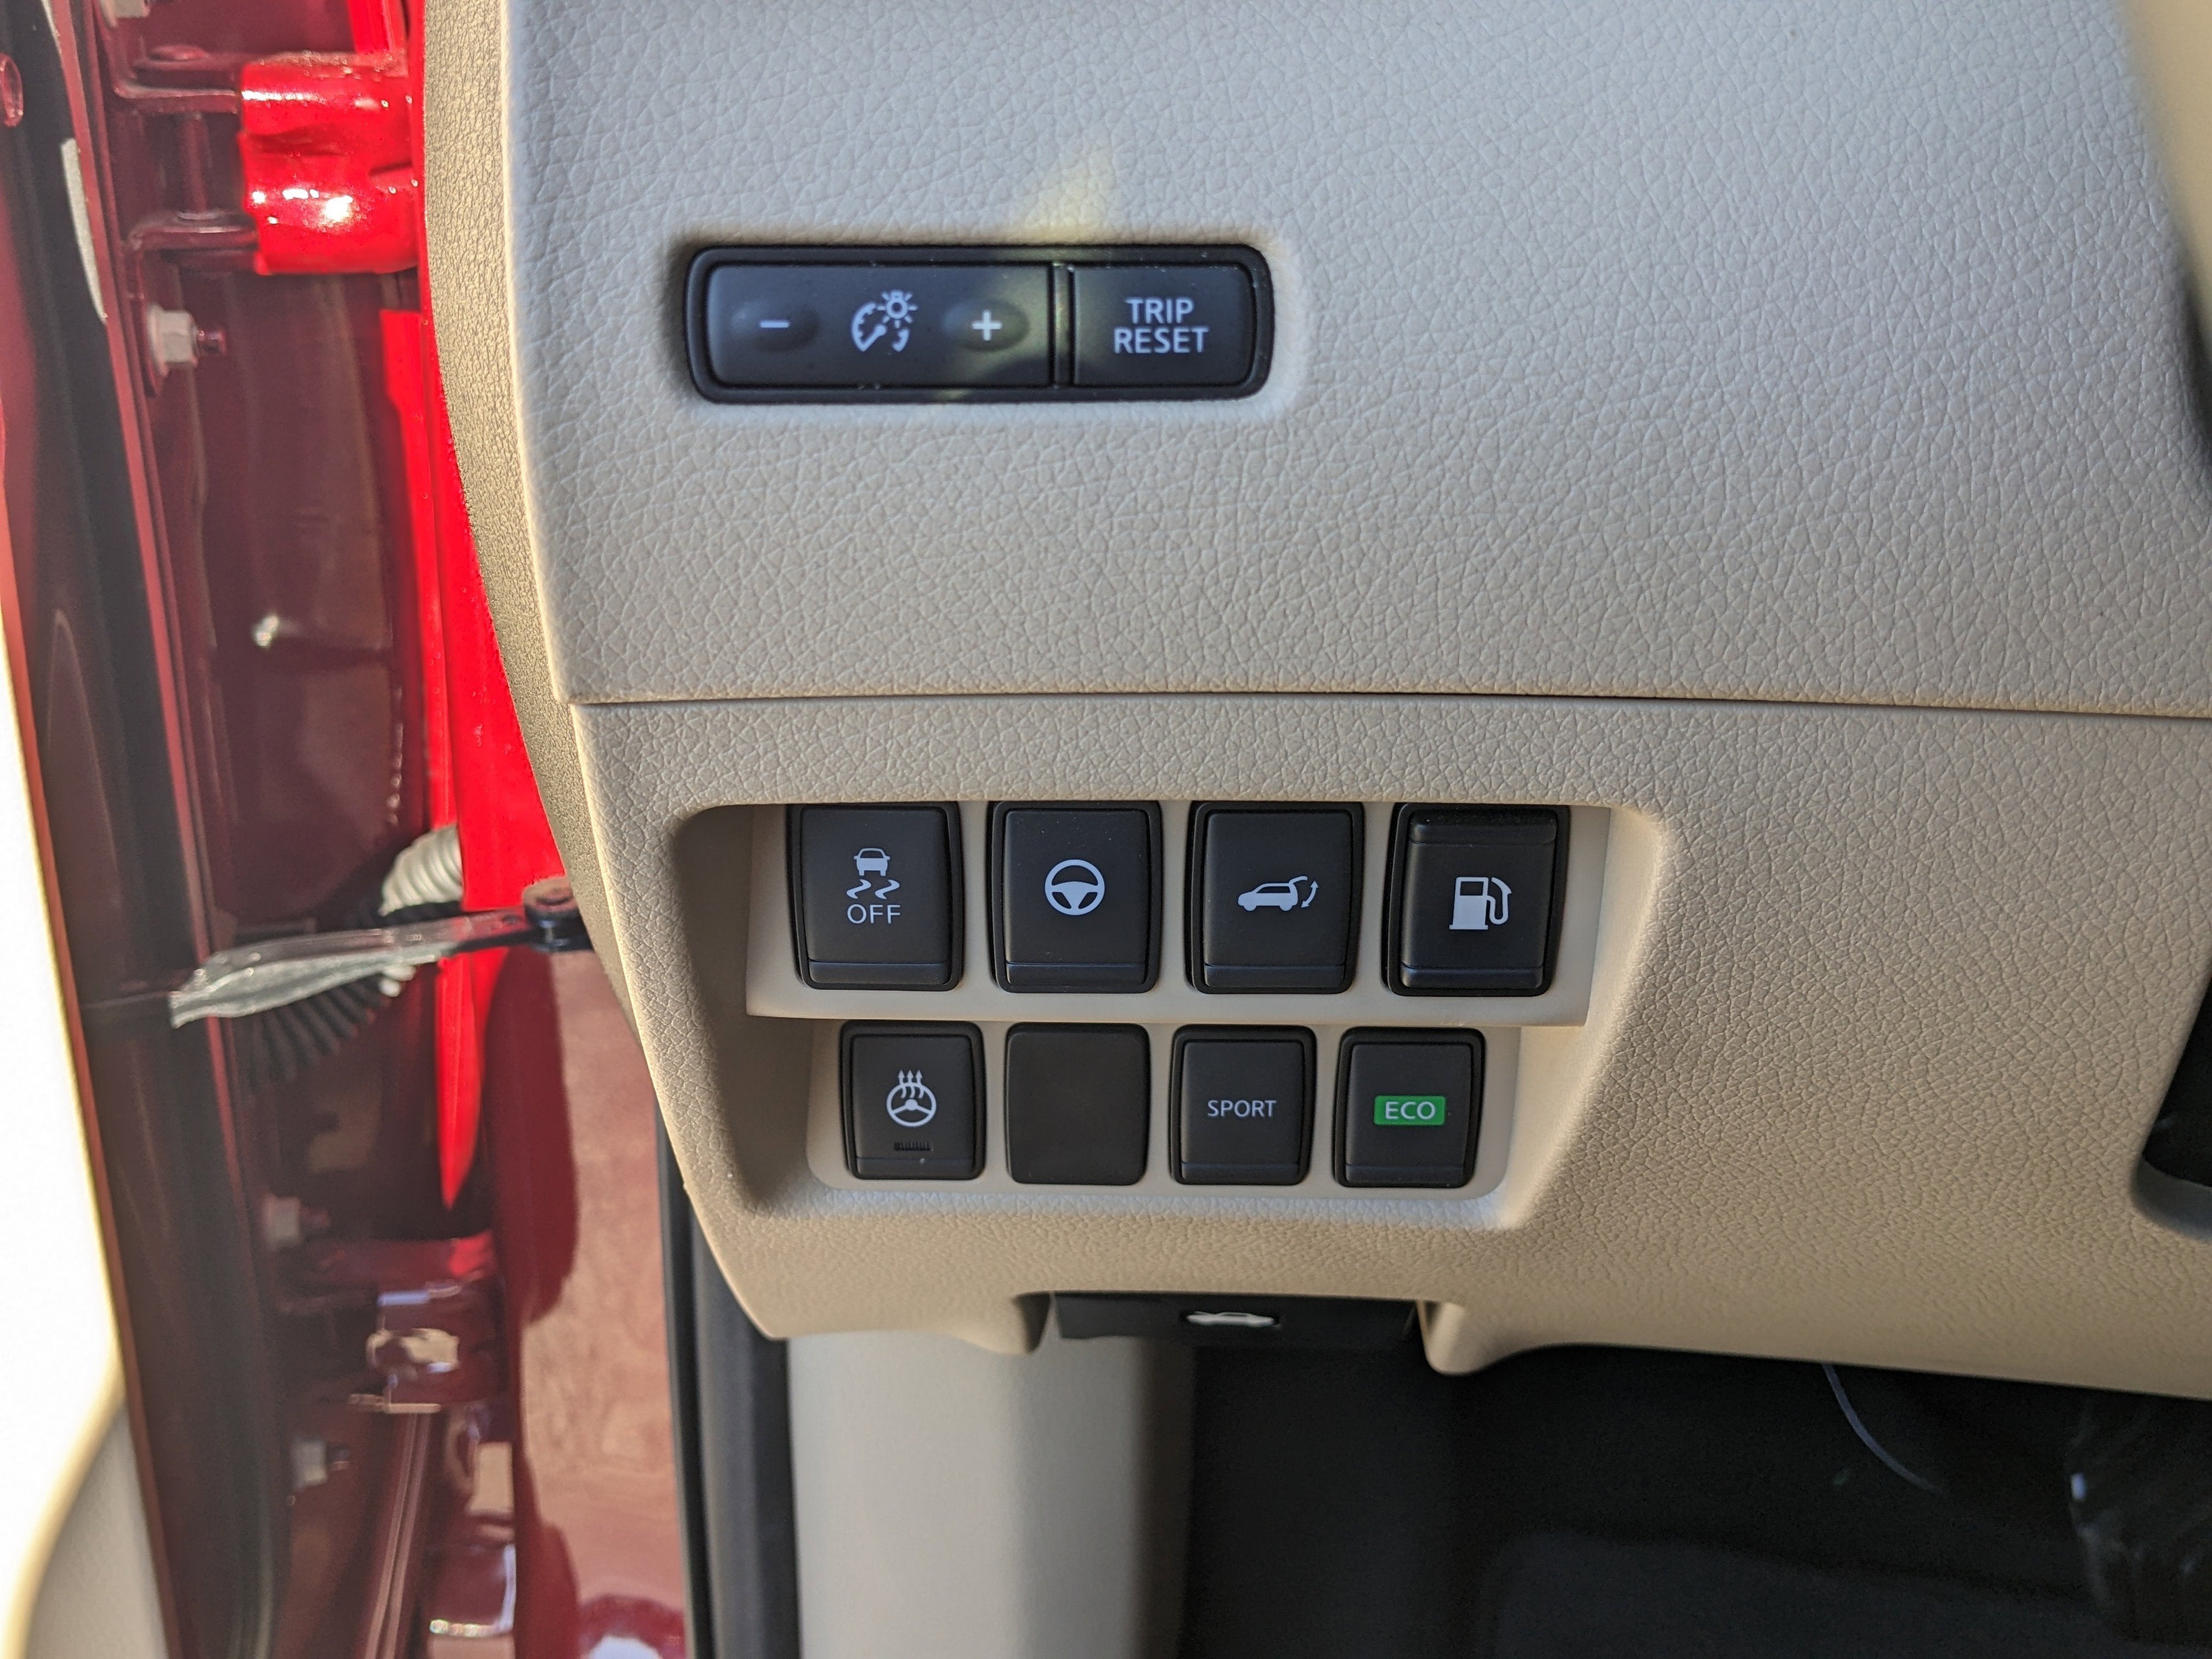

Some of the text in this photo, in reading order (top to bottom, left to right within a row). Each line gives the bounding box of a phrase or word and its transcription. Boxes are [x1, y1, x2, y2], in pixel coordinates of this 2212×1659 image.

[1125, 297, 1195, 324] TRIP
[1114, 326, 1210, 353] RESET
[847, 904, 901, 924] OFF
[1207, 1099, 1277, 1118] SPORT
[1385, 1101, 1436, 1120] ECO
